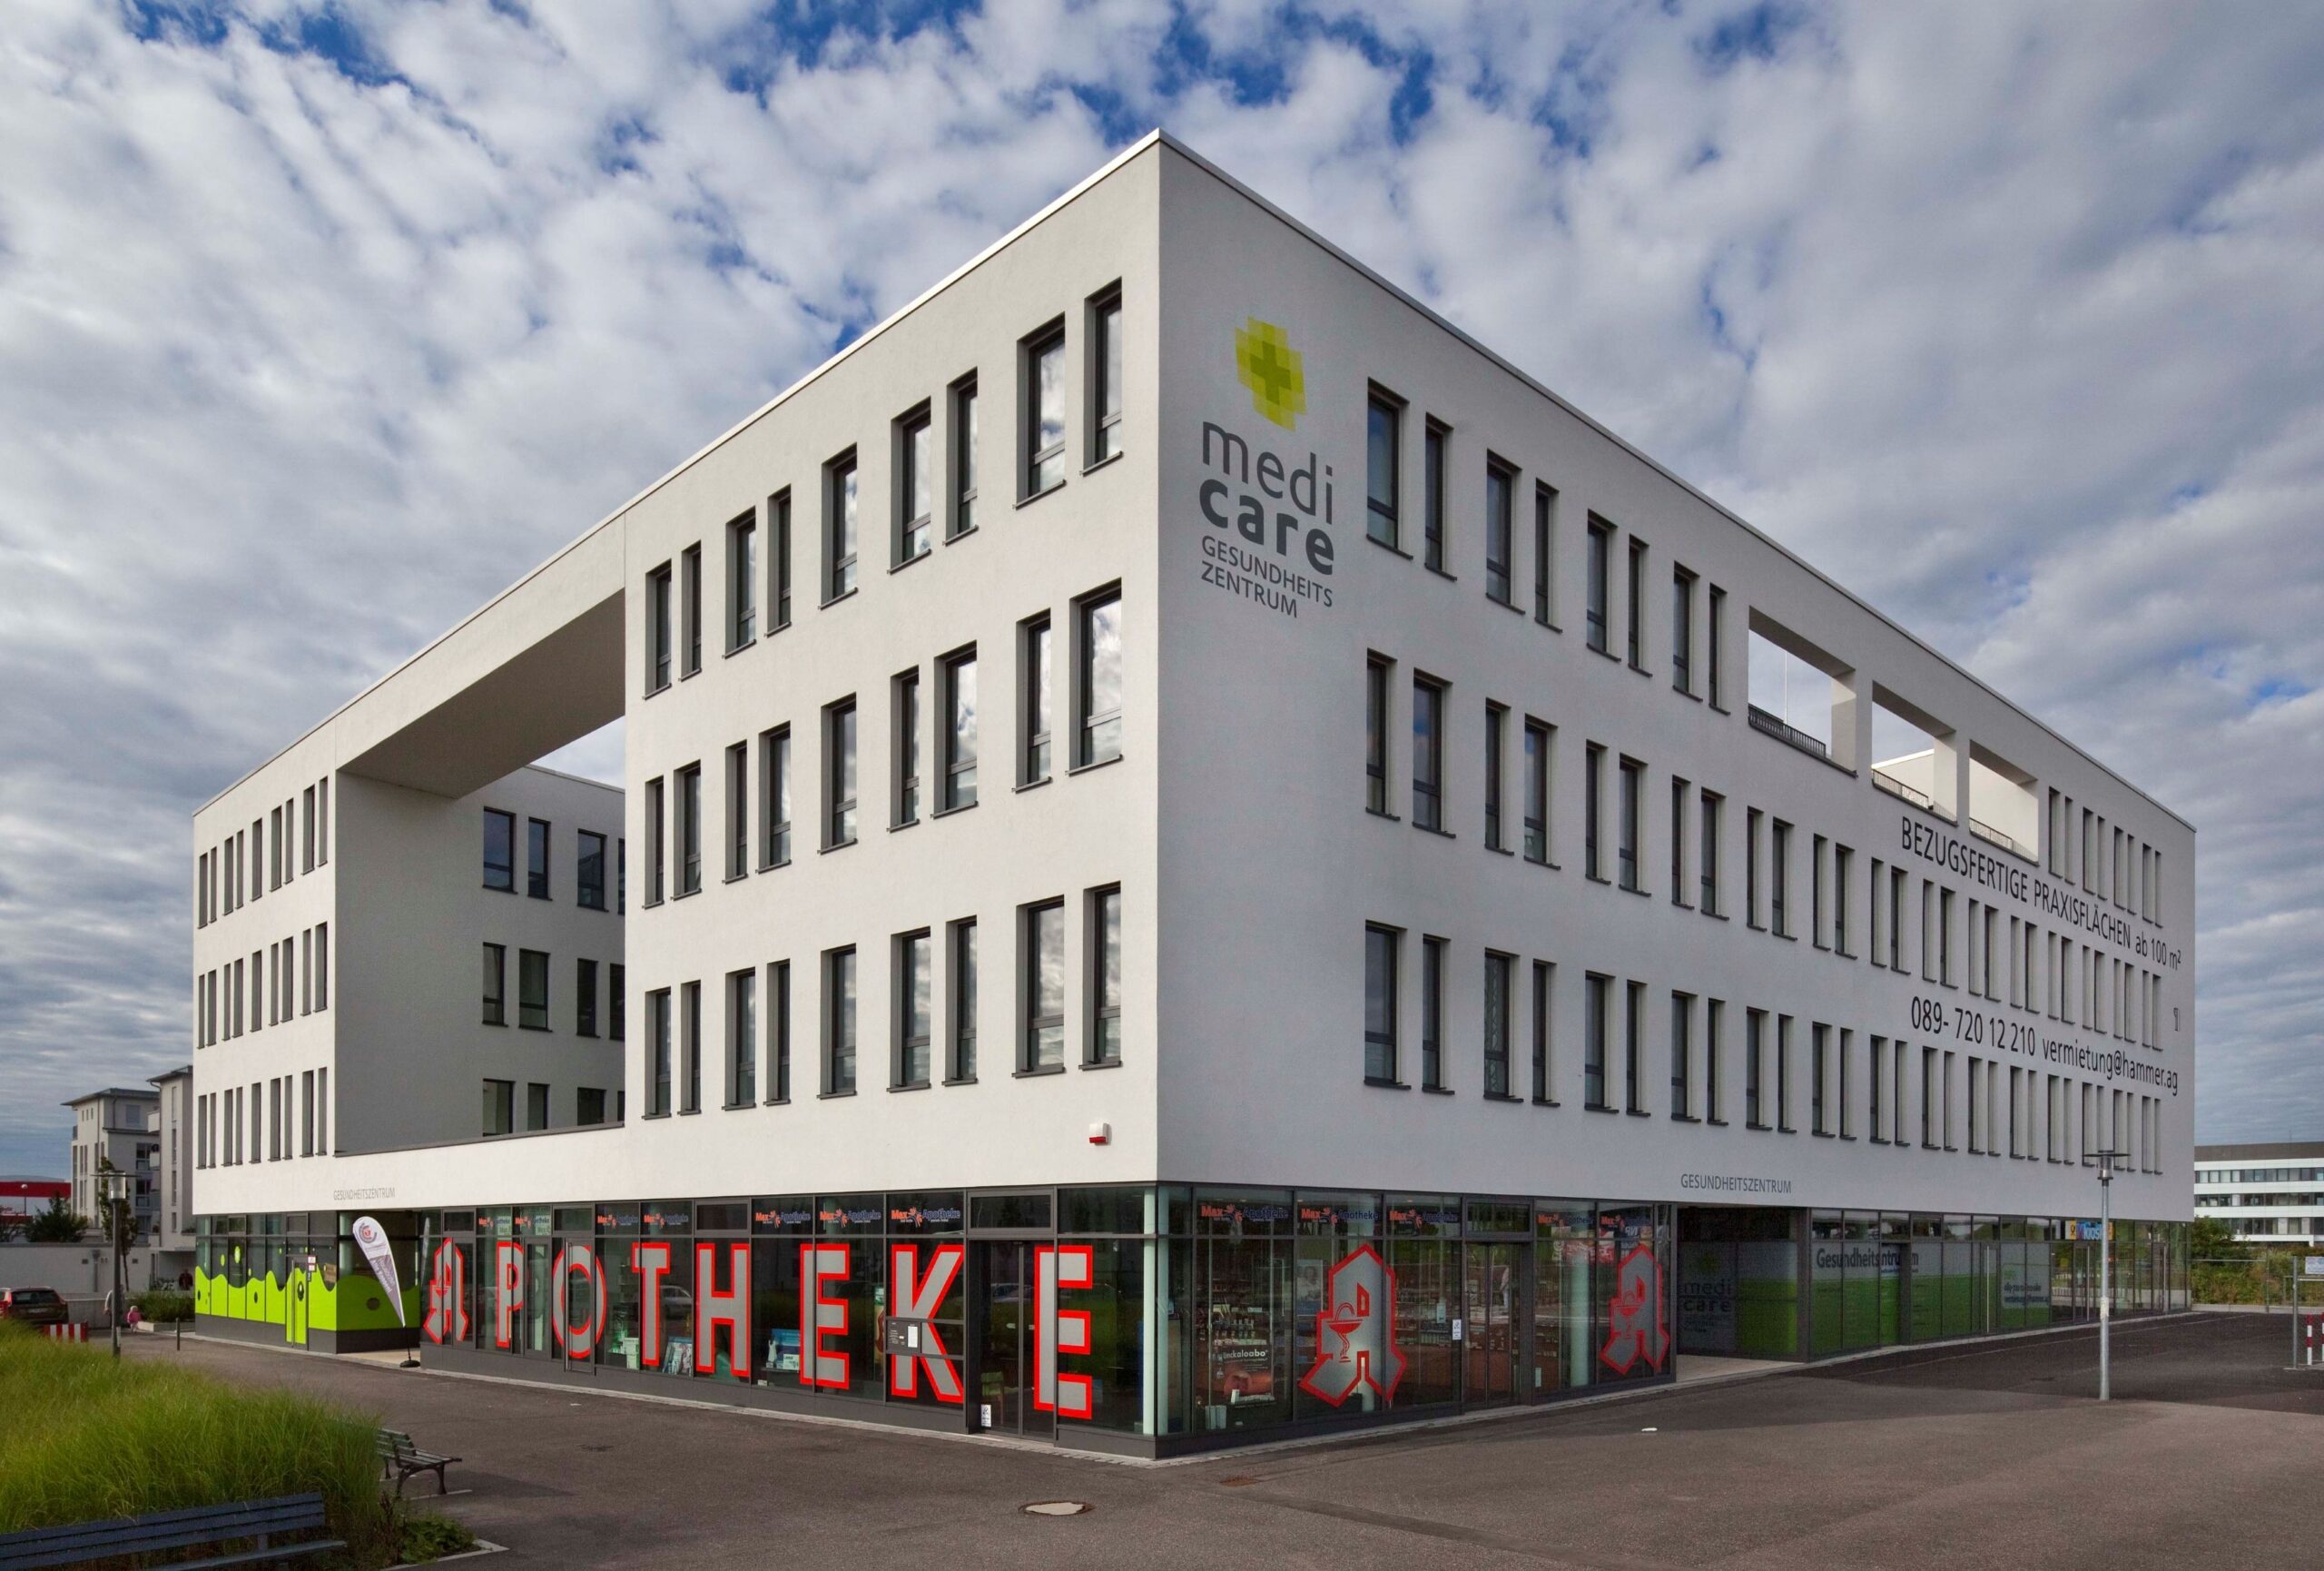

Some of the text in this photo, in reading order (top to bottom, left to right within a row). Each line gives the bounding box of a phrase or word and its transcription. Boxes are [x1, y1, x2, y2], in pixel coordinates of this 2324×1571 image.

[1202, 420, 1333, 525] medi
[1199, 479, 1334, 576] care
[1201, 535, 1333, 608] GESUNDHEITS
[1201, 560, 1297, 618] ZENTRUM
[1902, 815, 2028, 903] BEZUGSFERTIGE
[2034, 879, 2131, 949] PRAXISFLÄCHEN
[2135, 932, 2148, 957] ab
[2151, 938, 2167, 966] 100
[1911, 995, 2178, 1096] 089- 720 12 210 vermietung@hammer.ag
[333, 1187, 396, 1200] GESUNDHEITSZENTRUM
[1680, 1173, 1792, 1194] GESUNDHEITSZENTRUM
[755, 1212, 769, 1221] Max
[820, 1210, 835, 1220] Max
[891, 1208, 960, 1220] Max Apotheke
[1201, 1205, 1223, 1218] Max
[1301, 1208, 1320, 1220] Max
